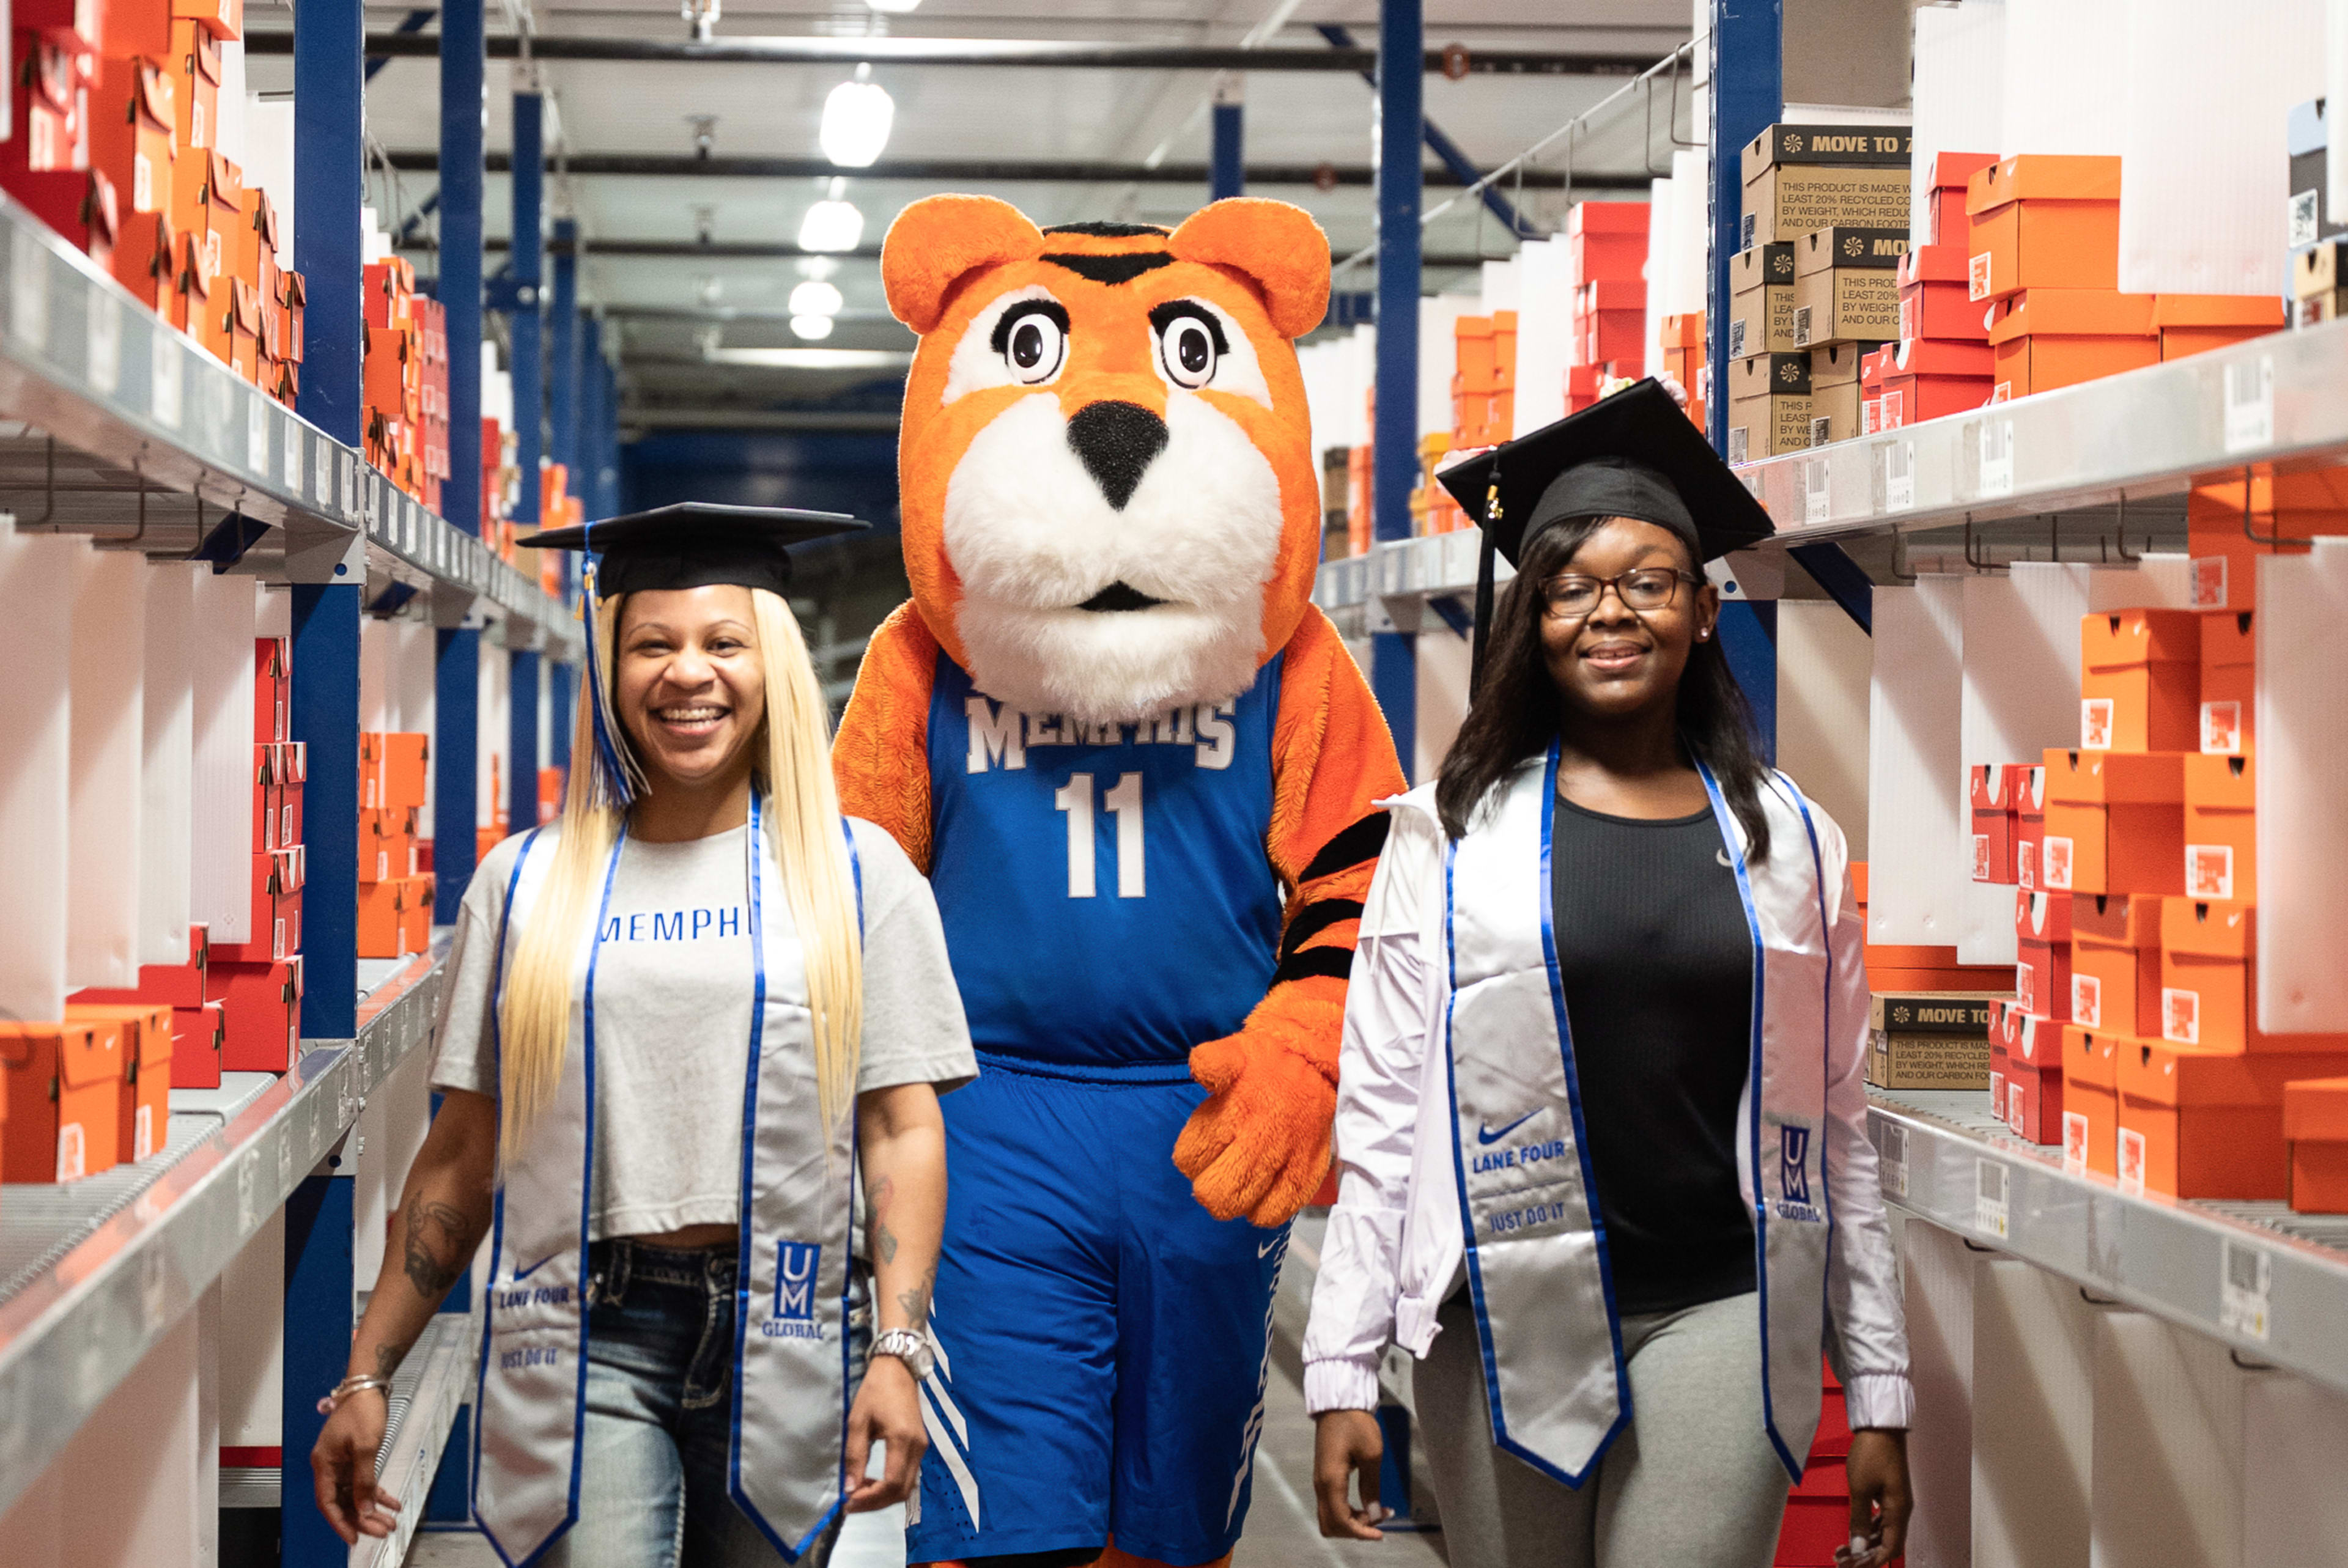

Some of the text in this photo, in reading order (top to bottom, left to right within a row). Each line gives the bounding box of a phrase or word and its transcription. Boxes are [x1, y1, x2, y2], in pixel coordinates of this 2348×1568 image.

[1812, 136, 1867, 152] MOVE
[1874, 137, 1899, 152] TO
[1782, 183, 1805, 192] THIS
[1807, 183, 1856, 193] PRODUCT
[1859, 184, 1869, 193] IS
[1871, 184, 1900, 193] MADE
[1782, 194, 1813, 204] LEAST
[1815, 195, 1837, 204] 20%
[1840, 196, 1894, 205] RECYCLED
[1782, 206, 1796, 215] BY
[1798, 207, 1839, 217] WEIGHT,
[1842, 207, 1877, 216] WHICH
[1781, 218, 1803, 227] AND
[1806, 219, 1828, 227] OUR
[1830, 219, 1874, 228] CARBON
[1874, 239, 1910, 256] MO
[1843, 278, 1866, 287] THIS
[1774, 293, 1795, 302] THIS
[1843, 290, 1900, 300] LEAST 20%
[1842, 302, 1856, 311] BY
[1774, 317, 1787, 326] BY
[1842, 315, 1864, 324] AND
[1867, 315, 1889, 325] OUR
[1774, 329, 1795, 337] AND
[1781, 401, 1803, 410] THIS
[1780, 413, 1811, 422] LEAST
[1780, 425, 1794, 434] BY
[1779, 437, 1801, 446] AND
[1055, 771, 1145, 898] 11
[1918, 1008, 1989, 1023] MOVE TO
[1917, 1041, 1958, 1050] PRODUCT
[1896, 1051, 1922, 1059] LEAST
[1944, 1051, 1990, 1060] RECYCLED
[1916, 1071, 1935, 1080] OUR
[1473, 1140, 1565, 1174] LANE FOUR
[1490, 1201, 1563, 1233] JUST DO IT
[1776, 1202, 1820, 1223] GLOBAL
[762, 1322, 825, 1340] GLOBAL
